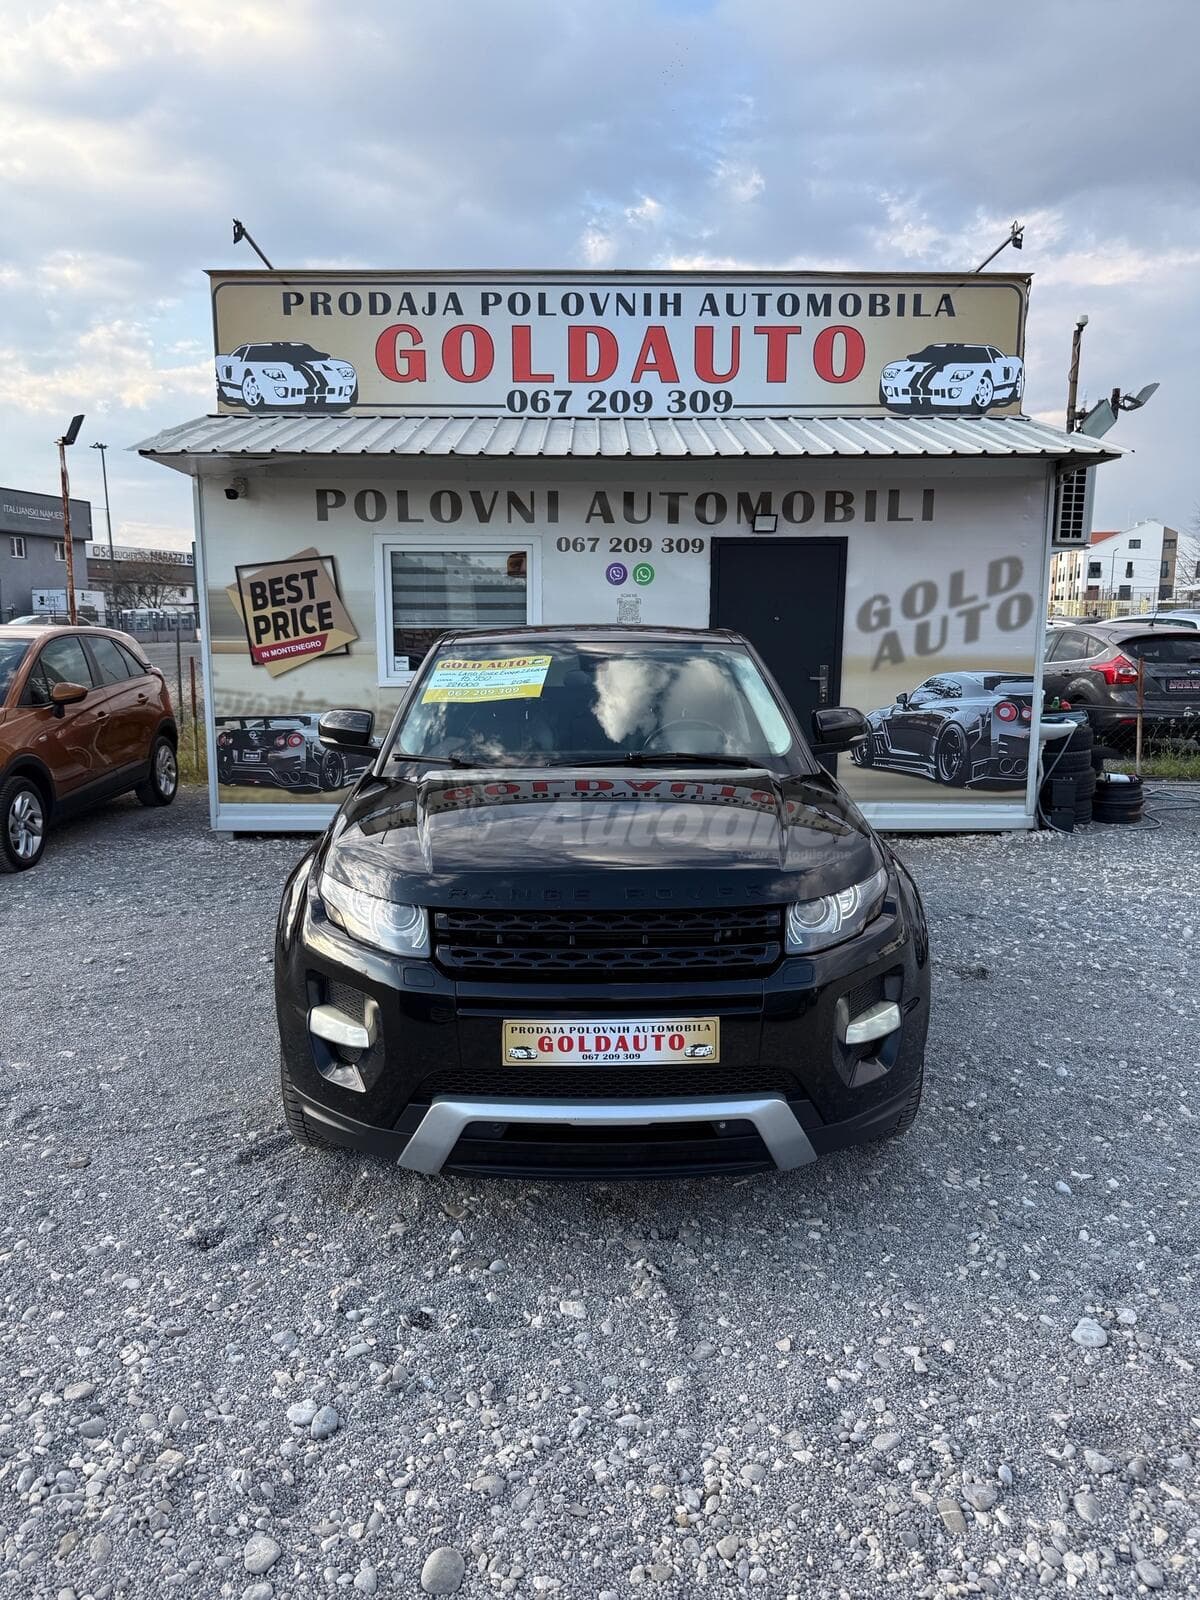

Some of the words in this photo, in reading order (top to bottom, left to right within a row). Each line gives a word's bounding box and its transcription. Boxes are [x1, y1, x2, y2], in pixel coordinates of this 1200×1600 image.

[281, 291, 464, 316] PRODAJA
[481, 292, 682, 317] POLOVNIH
[699, 292, 956, 317] AUTOMOBILA
[375, 323, 866, 384] GOLDAUTO
[506, 389, 573, 413] 067
[587, 389, 652, 413] 209
[666, 389, 734, 414] 309
[315, 488, 559, 524] POLOVNI
[585, 488, 935, 525] AUTOMOBILI
[555, 536, 600, 553] 067
[608, 537, 653, 553] 209
[660, 537, 705, 554] 309
[249, 569, 319, 612] BEST
[856, 555, 1024, 633] GOLD
[253, 601, 334, 645] PRICE
[871, 592, 1035, 672] AUTO
[261, 651, 270, 659] IN
[271, 640, 322, 658] MONTENEGRO
[440, 661, 483, 670] GOLD
[487, 659, 527, 670] AUTO
[511, 1026, 566, 1035] PRODAJA
[569, 1025, 630, 1034] POLOVNIH
[634, 1024, 711, 1033] AUTOMOBILA
[537, 1033, 686, 1053] GOLDAUTO
